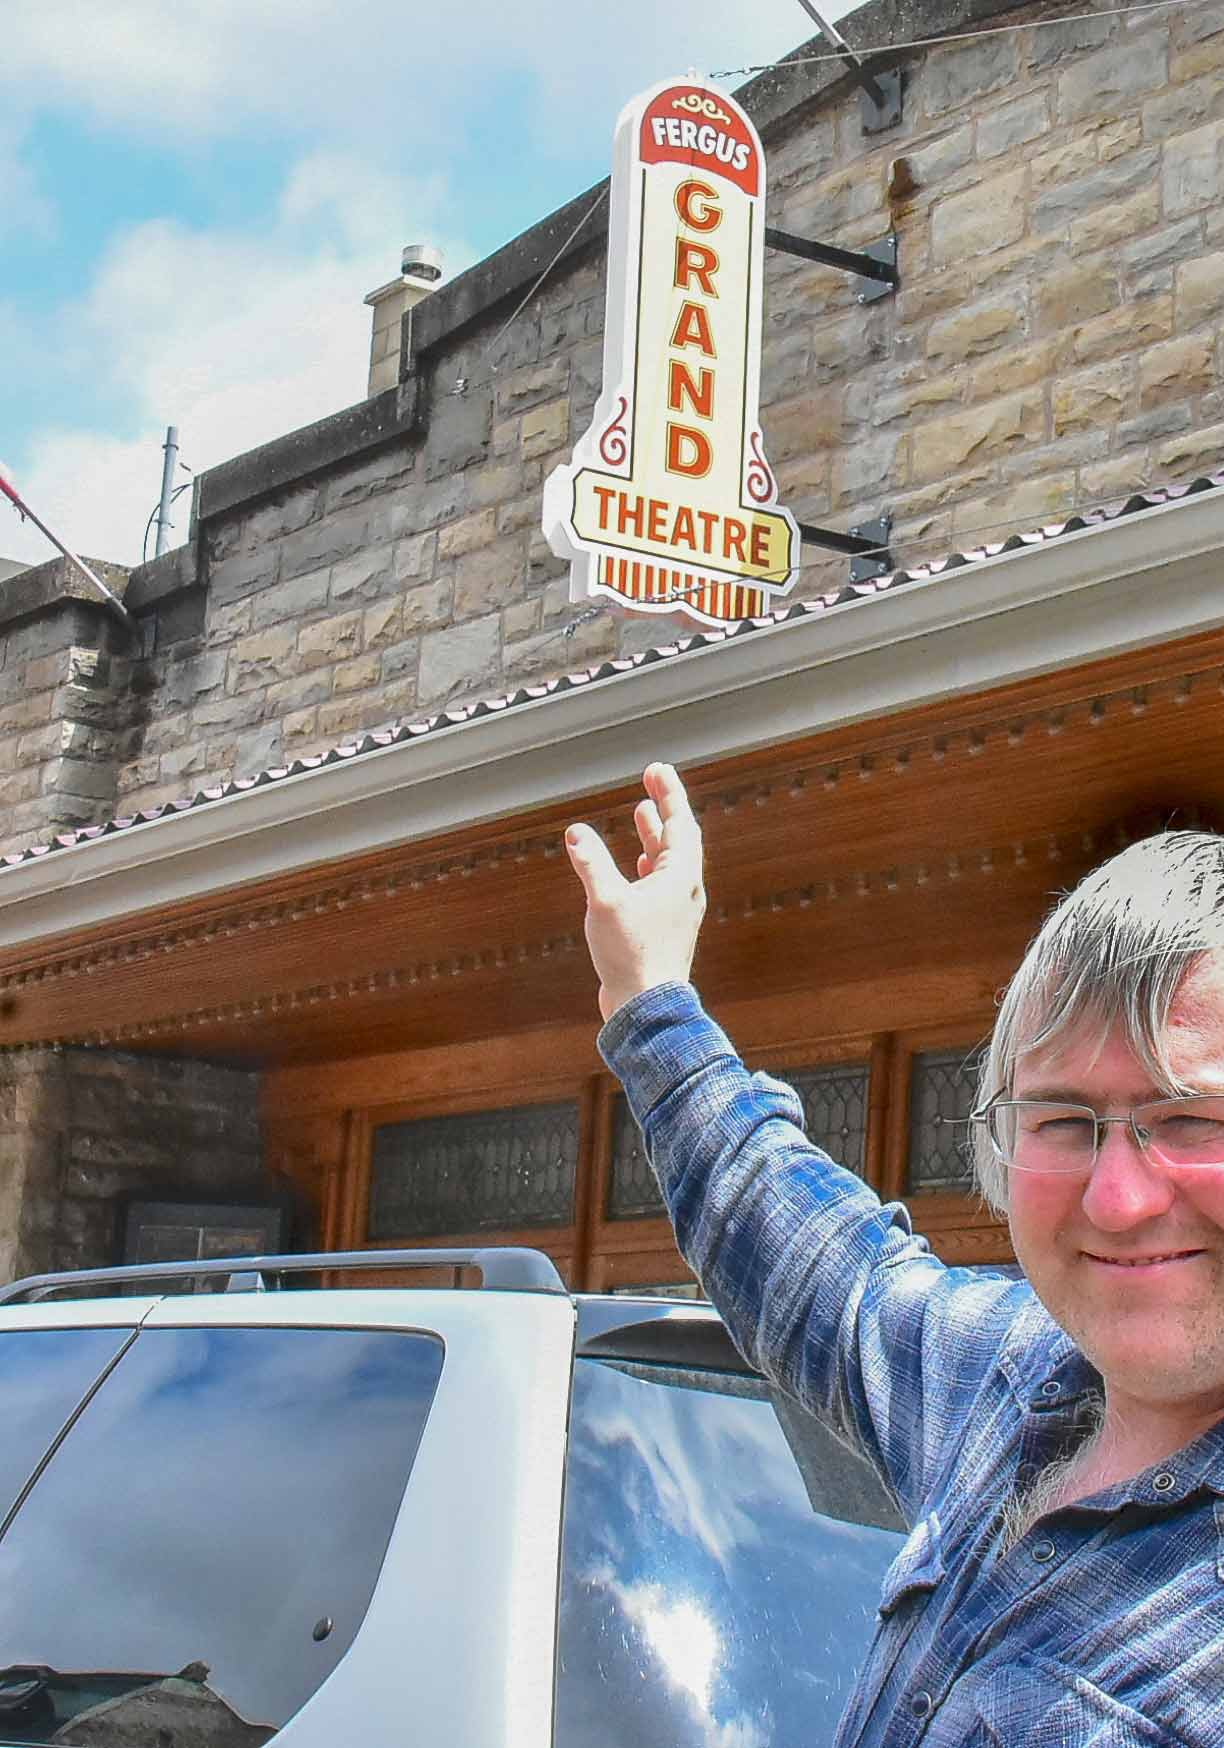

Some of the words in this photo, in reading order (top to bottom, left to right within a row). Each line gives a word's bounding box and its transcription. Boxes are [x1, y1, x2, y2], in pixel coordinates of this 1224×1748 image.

[650, 115, 752, 172] FERGUS
[664, 179, 723, 480] GRAND
[592, 485, 772, 568] THEATRE
